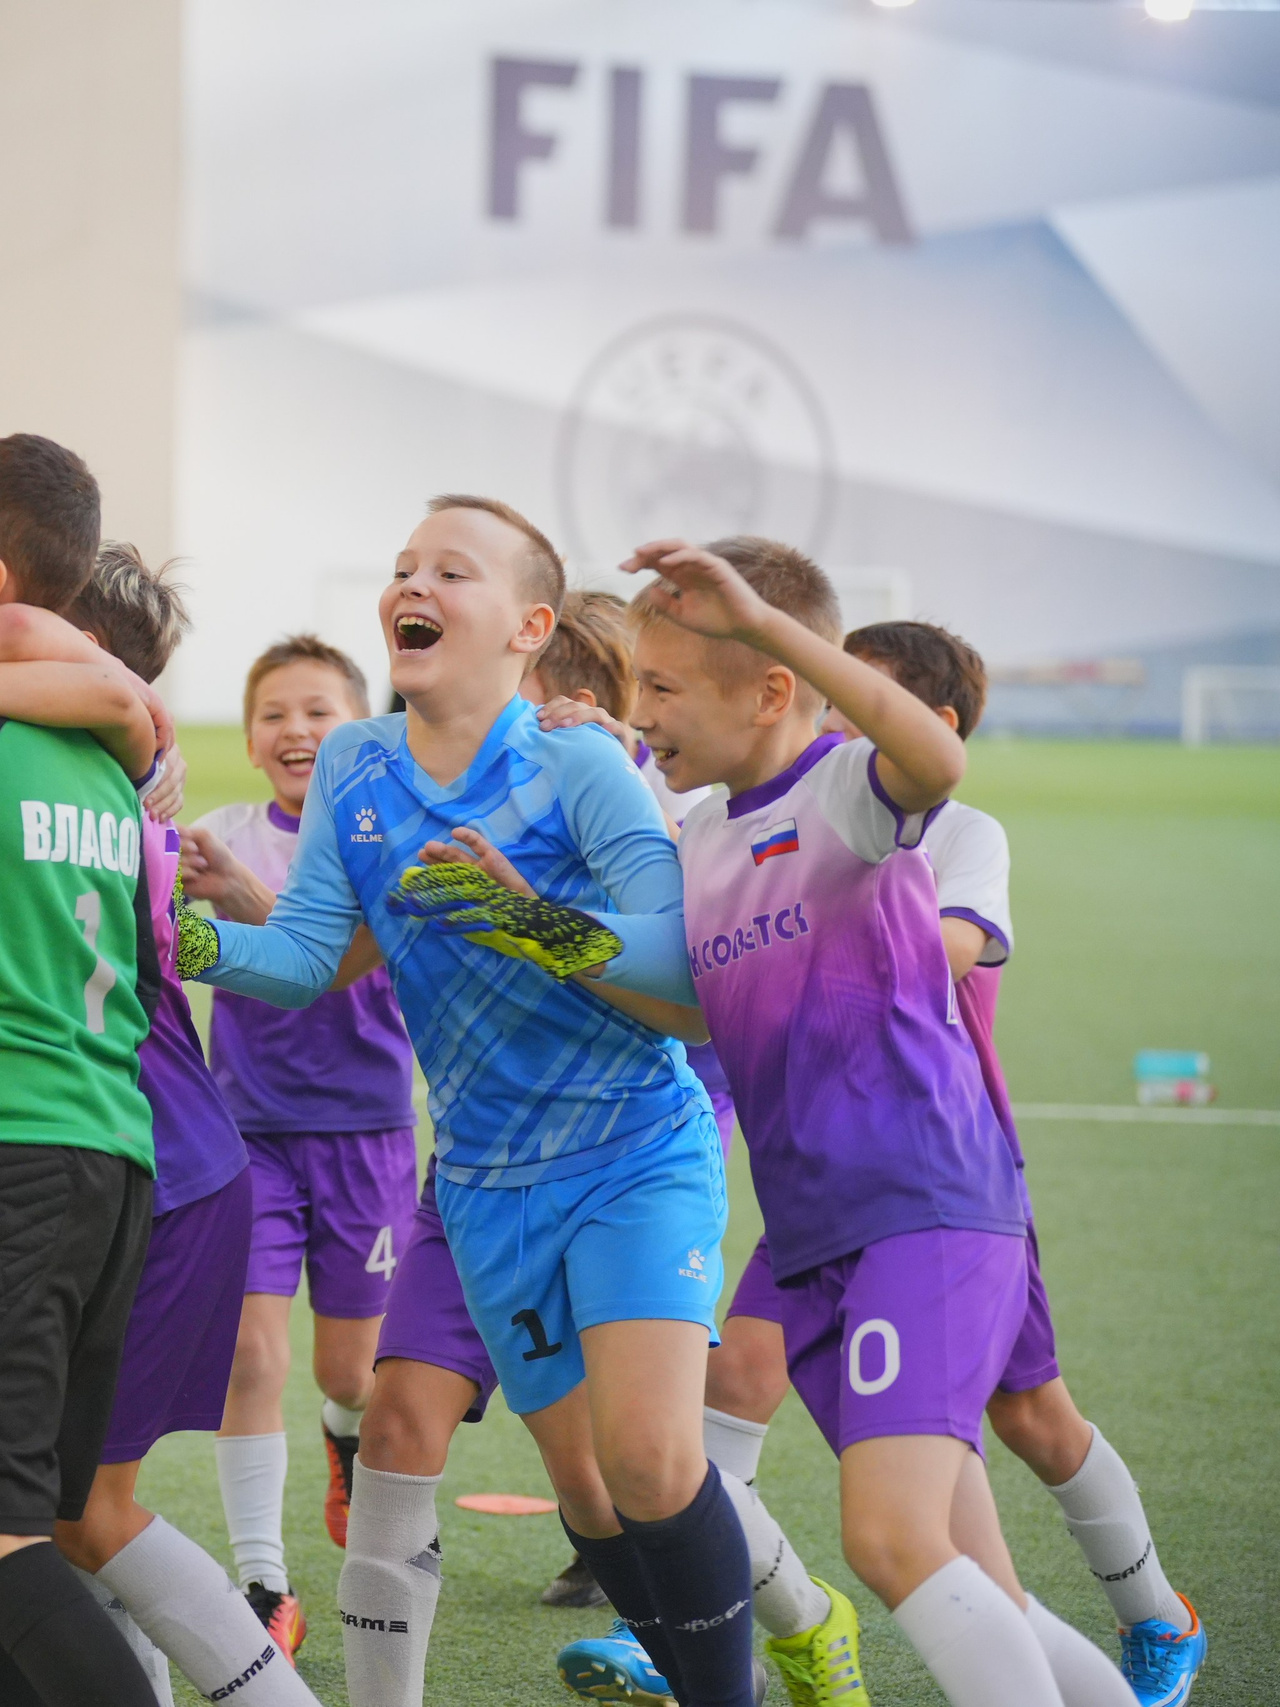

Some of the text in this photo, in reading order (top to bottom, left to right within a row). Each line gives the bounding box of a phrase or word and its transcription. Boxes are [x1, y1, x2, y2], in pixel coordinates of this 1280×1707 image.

[486, 56, 917, 247] FIFA
[350, 834, 384, 843] KELME
[74, 890, 117, 1034] 1
[364, 1224, 398, 1282] 4
[511, 1308, 563, 1362] 1
